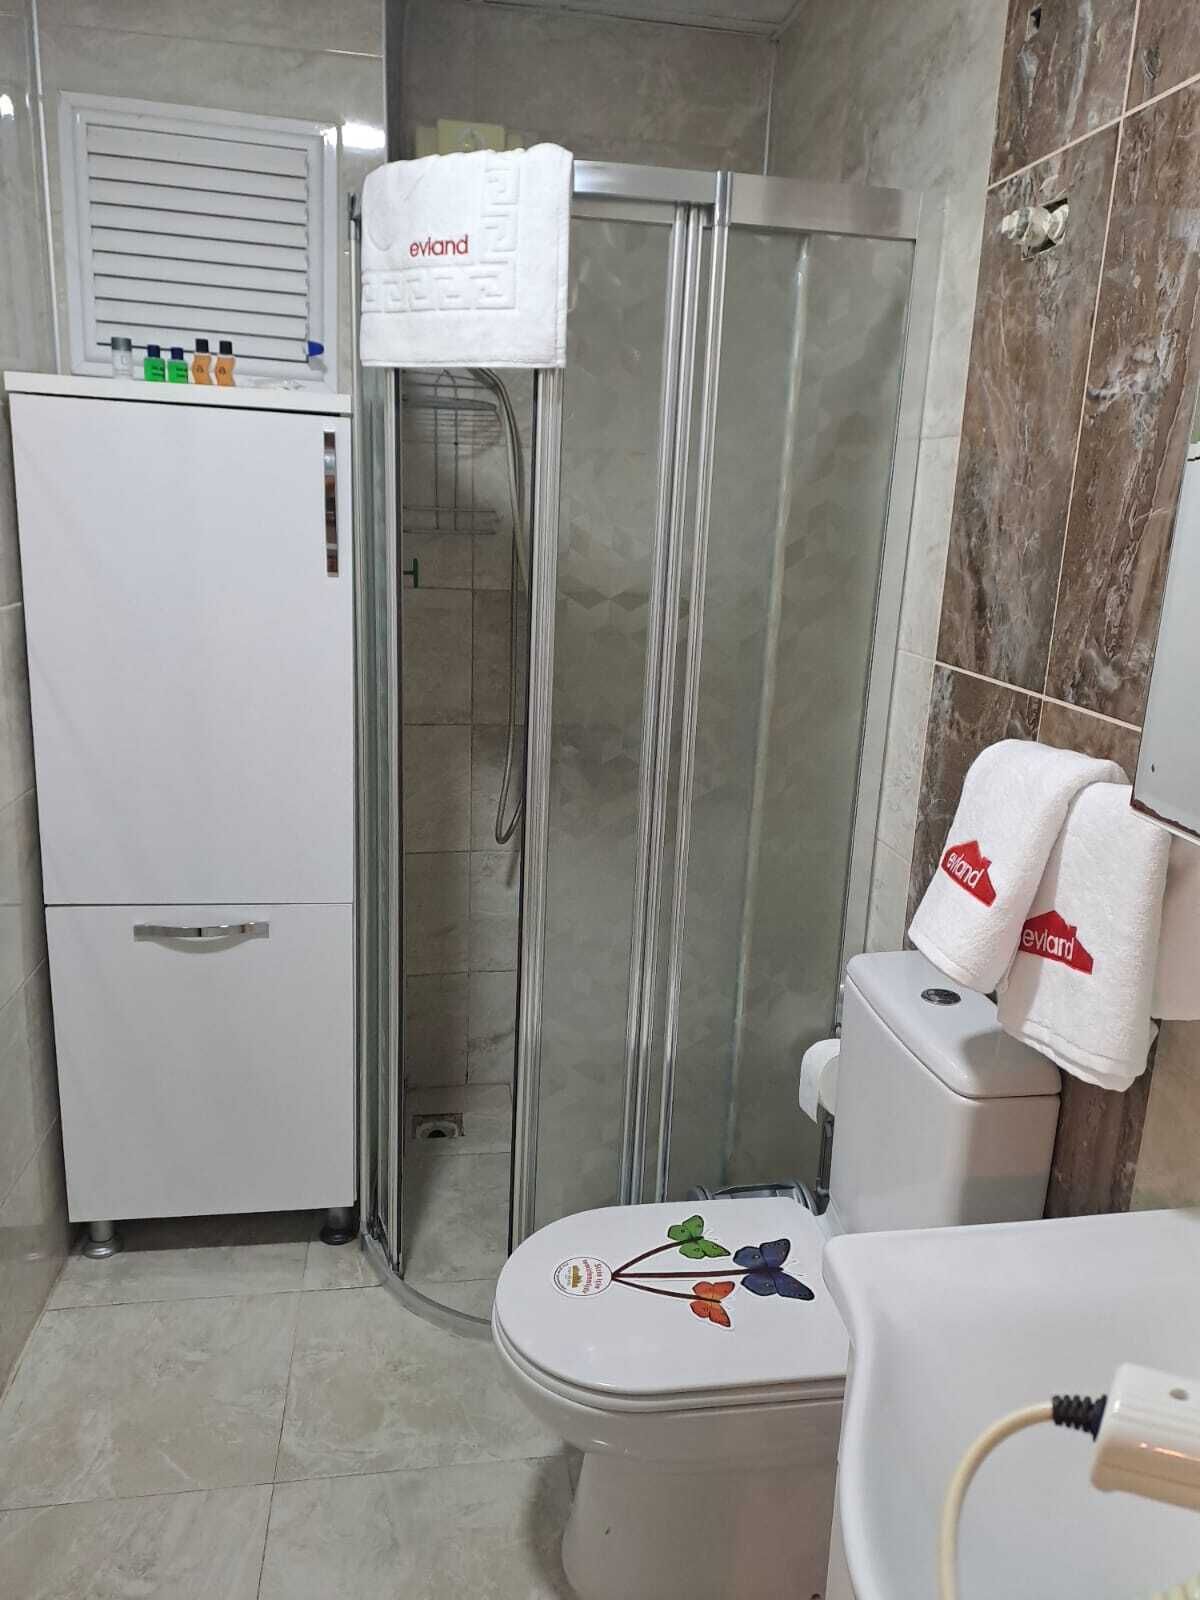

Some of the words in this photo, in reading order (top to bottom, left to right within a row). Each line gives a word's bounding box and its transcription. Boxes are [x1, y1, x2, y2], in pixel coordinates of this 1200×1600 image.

[409, 234, 469, 258] evland
[946, 852, 985, 889] evland
[1022, 928, 1075, 960] evland
